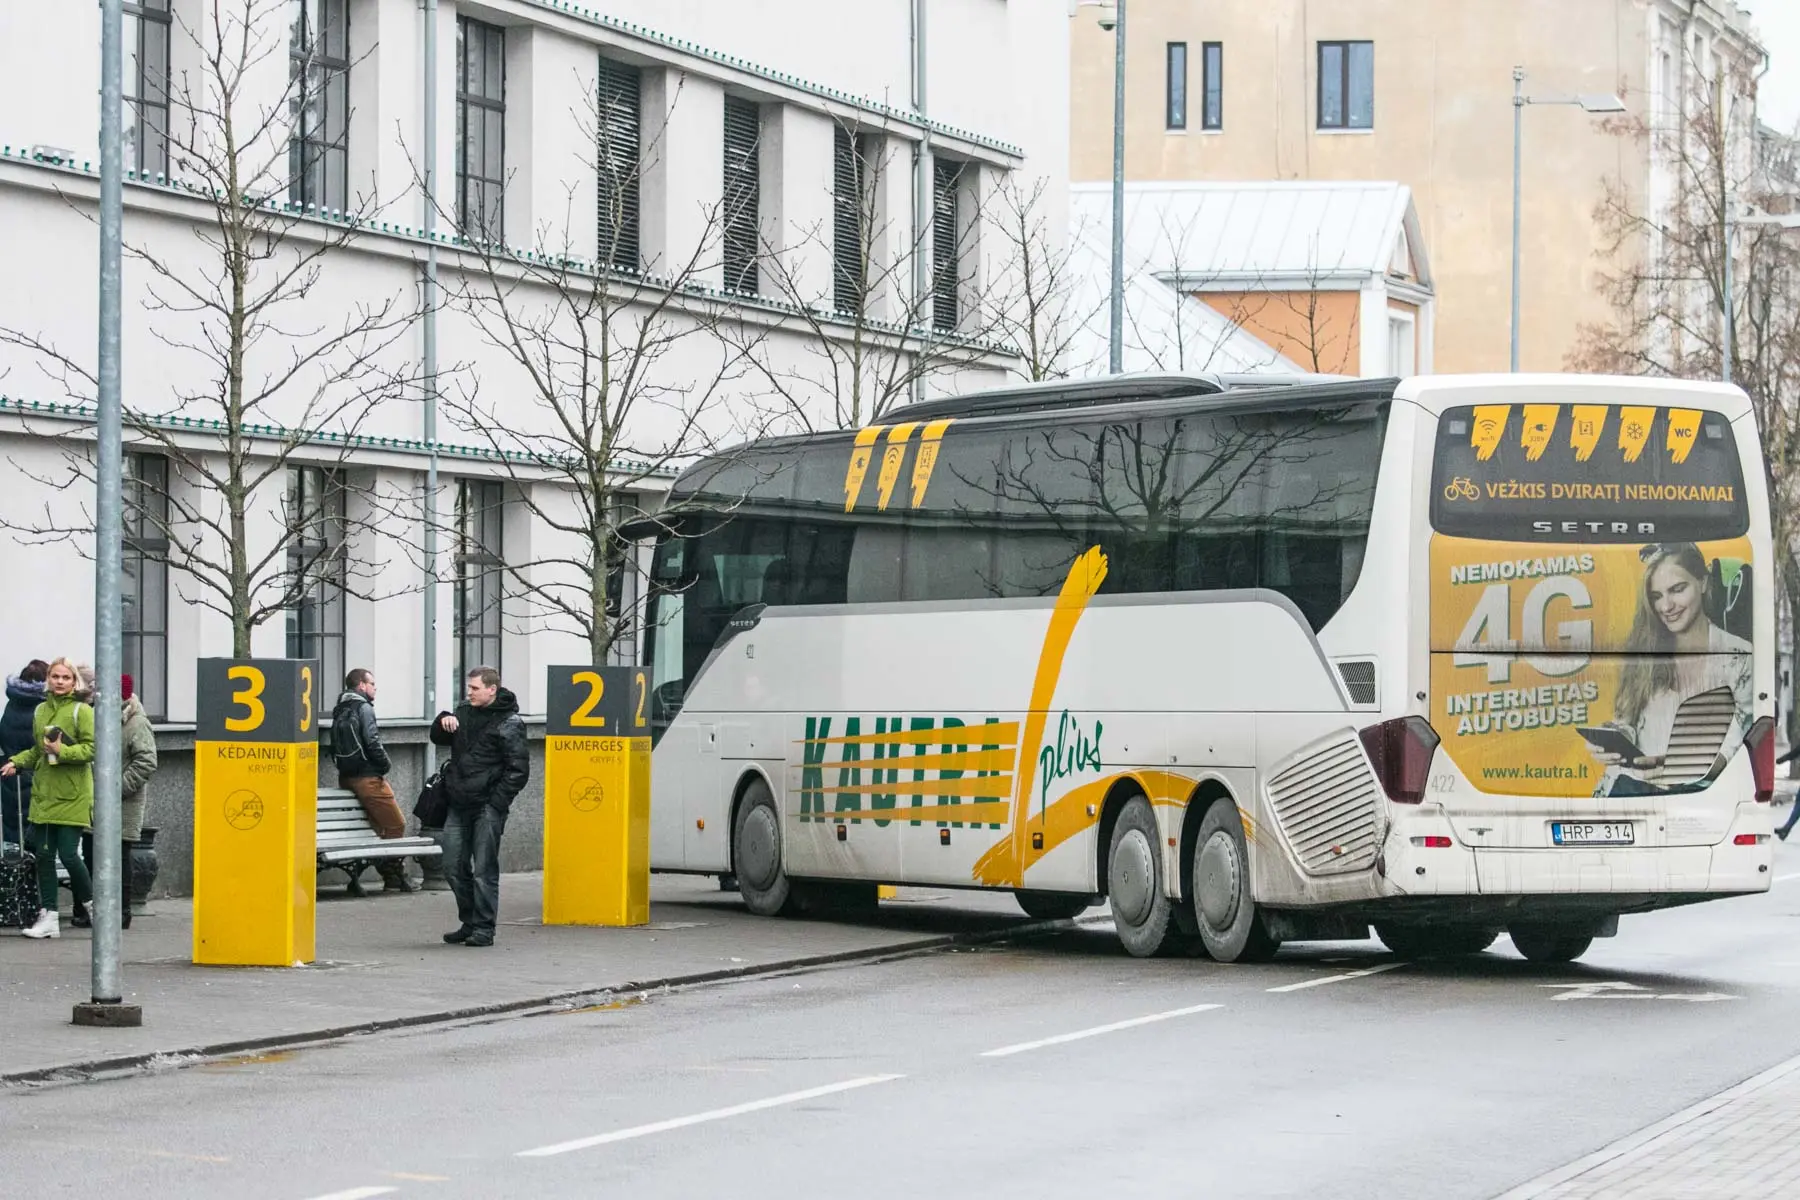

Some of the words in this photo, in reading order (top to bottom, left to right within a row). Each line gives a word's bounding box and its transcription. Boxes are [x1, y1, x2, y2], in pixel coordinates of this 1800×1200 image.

[1674, 428, 1692, 438] WC
[1485, 479, 1546, 499] VEŽKIS
[1551, 483, 1621, 503] DVIRATĮ
[1625, 485, 1734, 502] NEMOKAMAI
[1532, 520, 1656, 535] SETRA
[1450, 553, 1596, 585] NEMOKAMAS
[1452, 574, 1594, 684] 4G
[224, 665, 266, 732] 3
[300, 666, 312, 733] 3
[569, 671, 606, 727] 2
[634, 672, 646, 728] 2
[1447, 682, 1599, 715] INTERNETAS
[1456, 704, 1588, 736] AUTOBUSE
[218, 746, 287, 763] KĖDAINIŲ
[554, 739, 624, 752] UKMERGES
[248, 763, 287, 774] KRYPTIS
[800, 716, 1001, 830] KAUTRA
[1040, 708, 1102, 825] plius
[1482, 764, 1588, 779] www.kautra.lt
[1431, 774, 1456, 793] 422
[1562, 825, 1594, 839] HRP
[1604, 825, 1630, 839] 314
